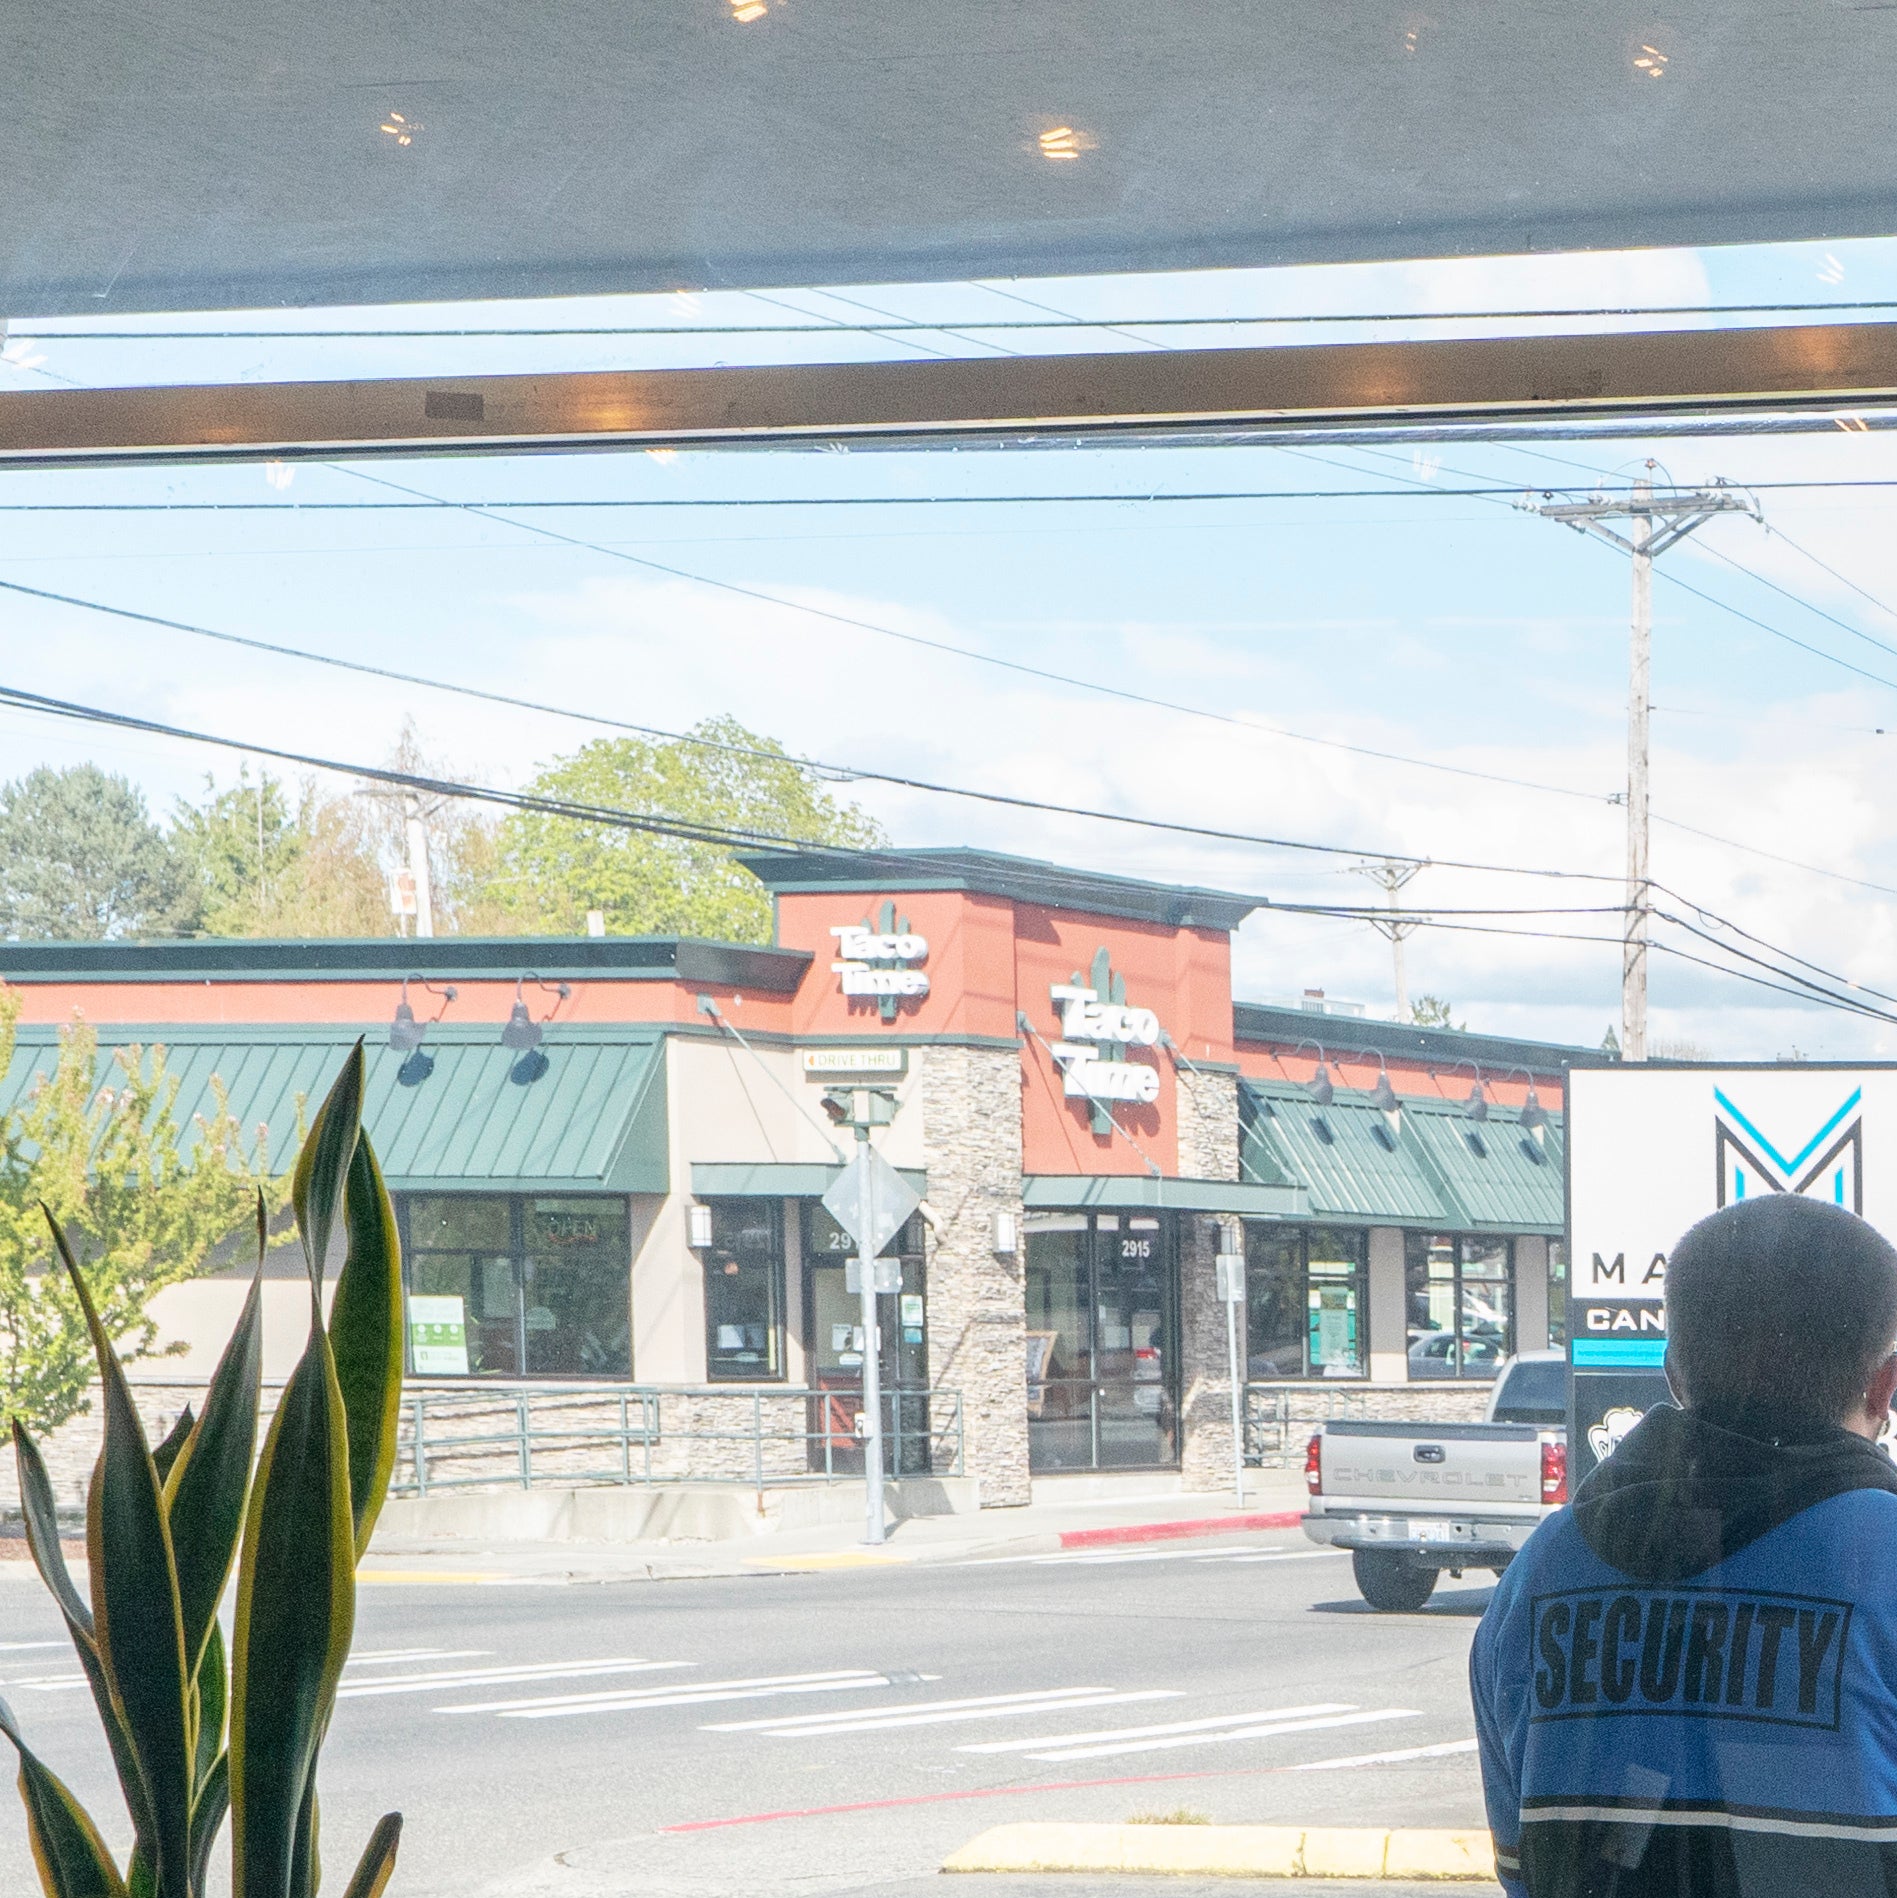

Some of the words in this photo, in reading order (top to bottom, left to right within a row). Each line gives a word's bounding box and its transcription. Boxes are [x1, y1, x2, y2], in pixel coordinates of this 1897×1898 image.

[829, 925, 927, 959] Taco
[830, 961, 929, 995] Time
[1050, 984, 1159, 1045] Taco
[818, 1054, 857, 1066] DRIVE
[861, 1054, 896, 1066] THRU
[1051, 1043, 1159, 1102] Time
[829, 1231, 852, 1250] 29
[1122, 1240, 1150, 1258] 2915
[1333, 1468, 1528, 1487] CHEVROLET
[1535, 1596, 1841, 1715] SECURITY
